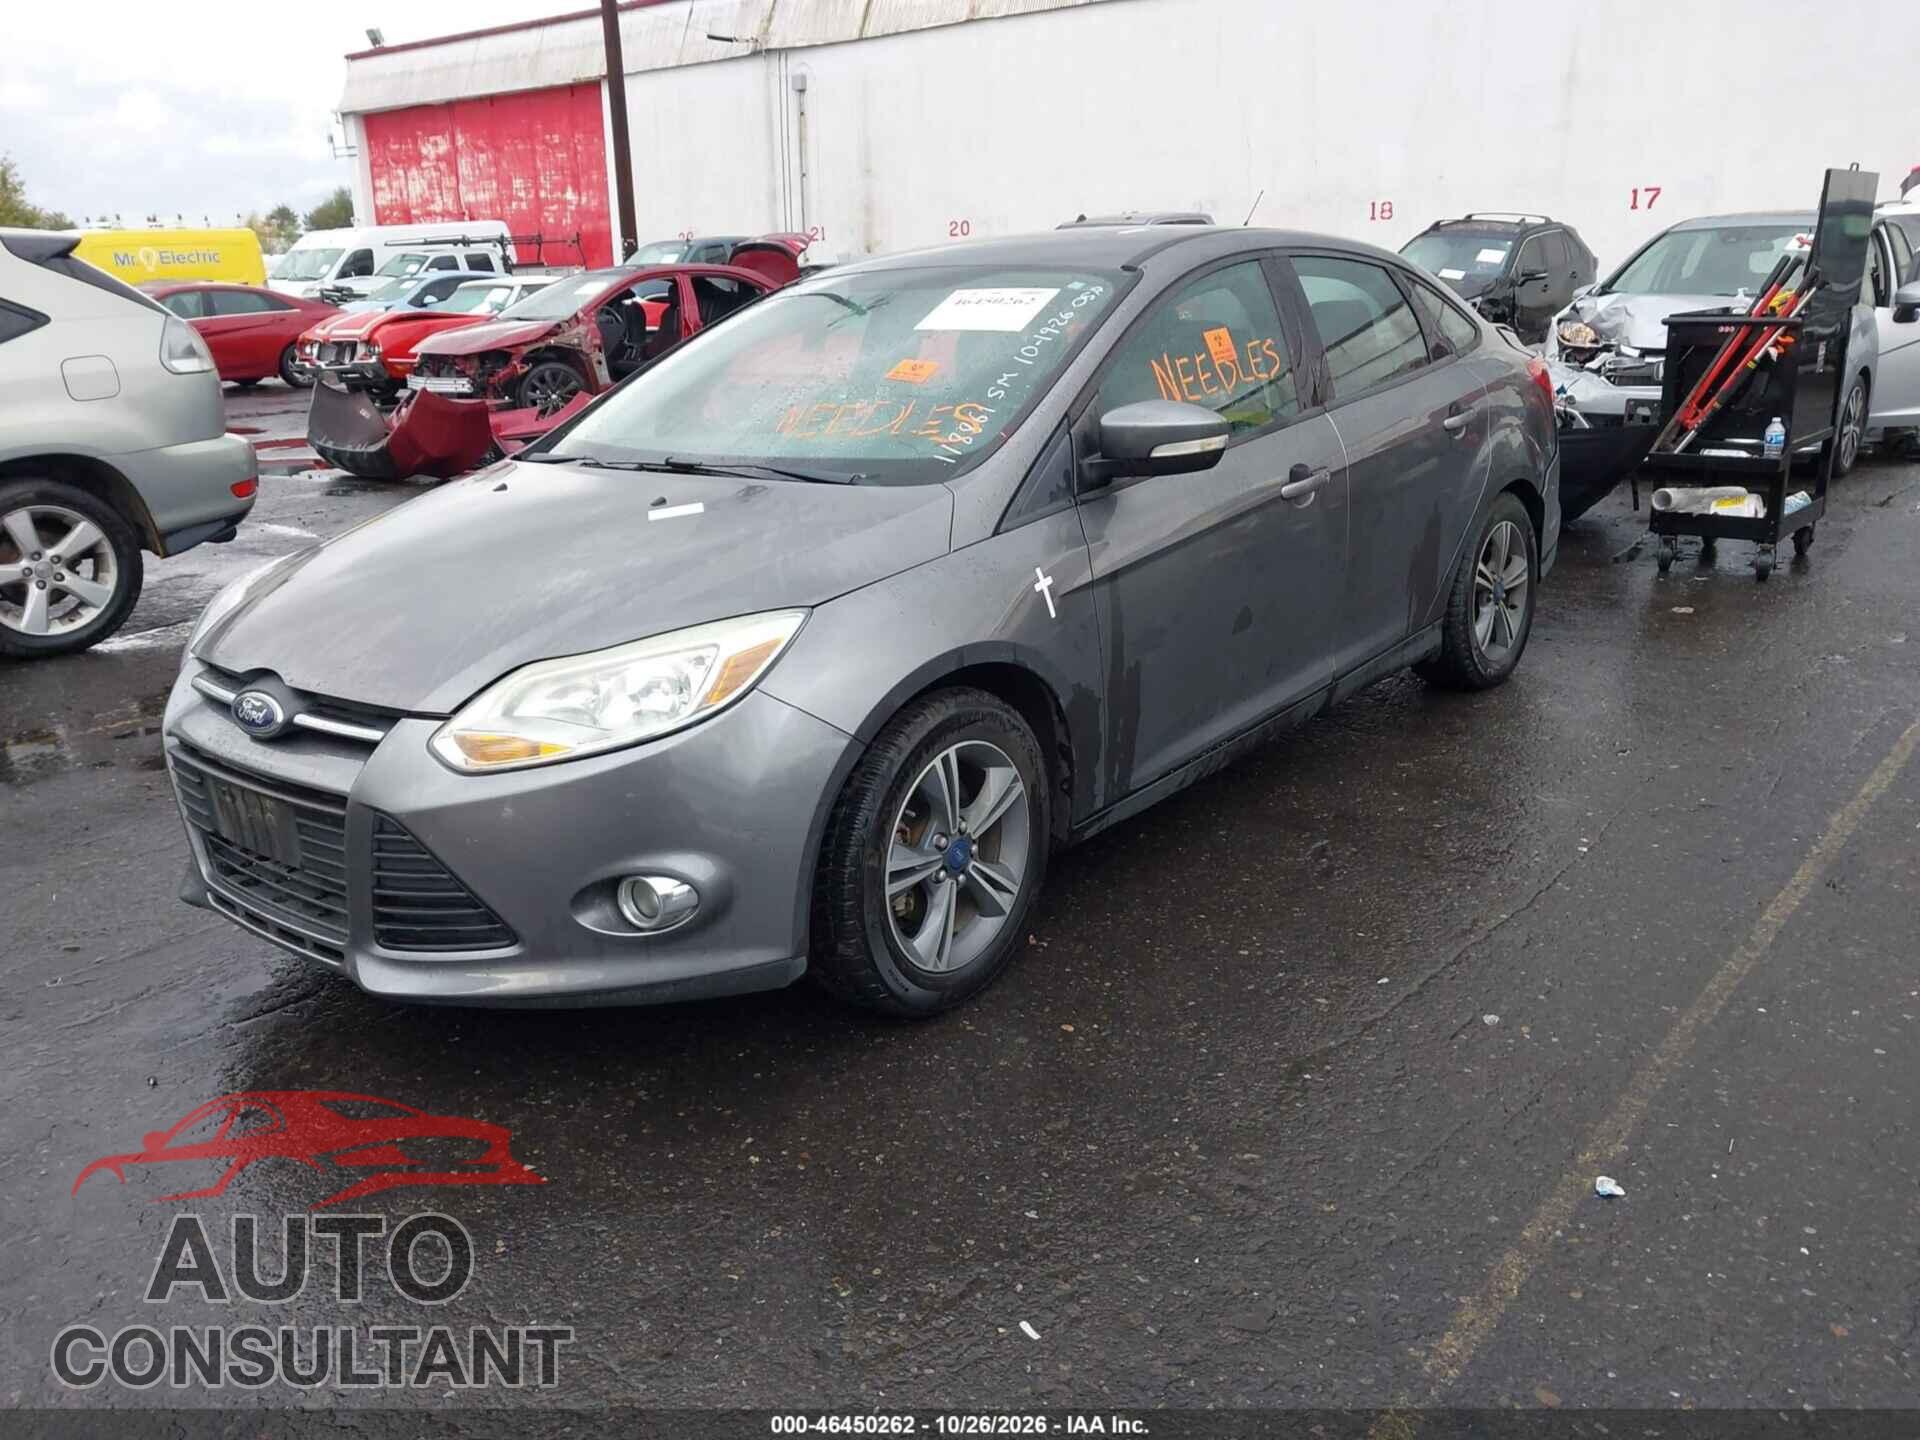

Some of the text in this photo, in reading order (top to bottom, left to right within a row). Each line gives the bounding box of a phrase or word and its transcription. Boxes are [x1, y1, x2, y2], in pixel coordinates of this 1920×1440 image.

[1630, 187, 1662, 210] 17
[1369, 201, 1394, 221] 18
[810, 226, 826, 242] 21
[949, 220, 971, 237] 20
[159, 248, 221, 265] Electric
[987, 372, 1019, 400] SM
[1012, 311, 1075, 365] 10-19-26
[1150, 338, 1281, 402] NEEDLES
[238, 697, 268, 724] Ford
